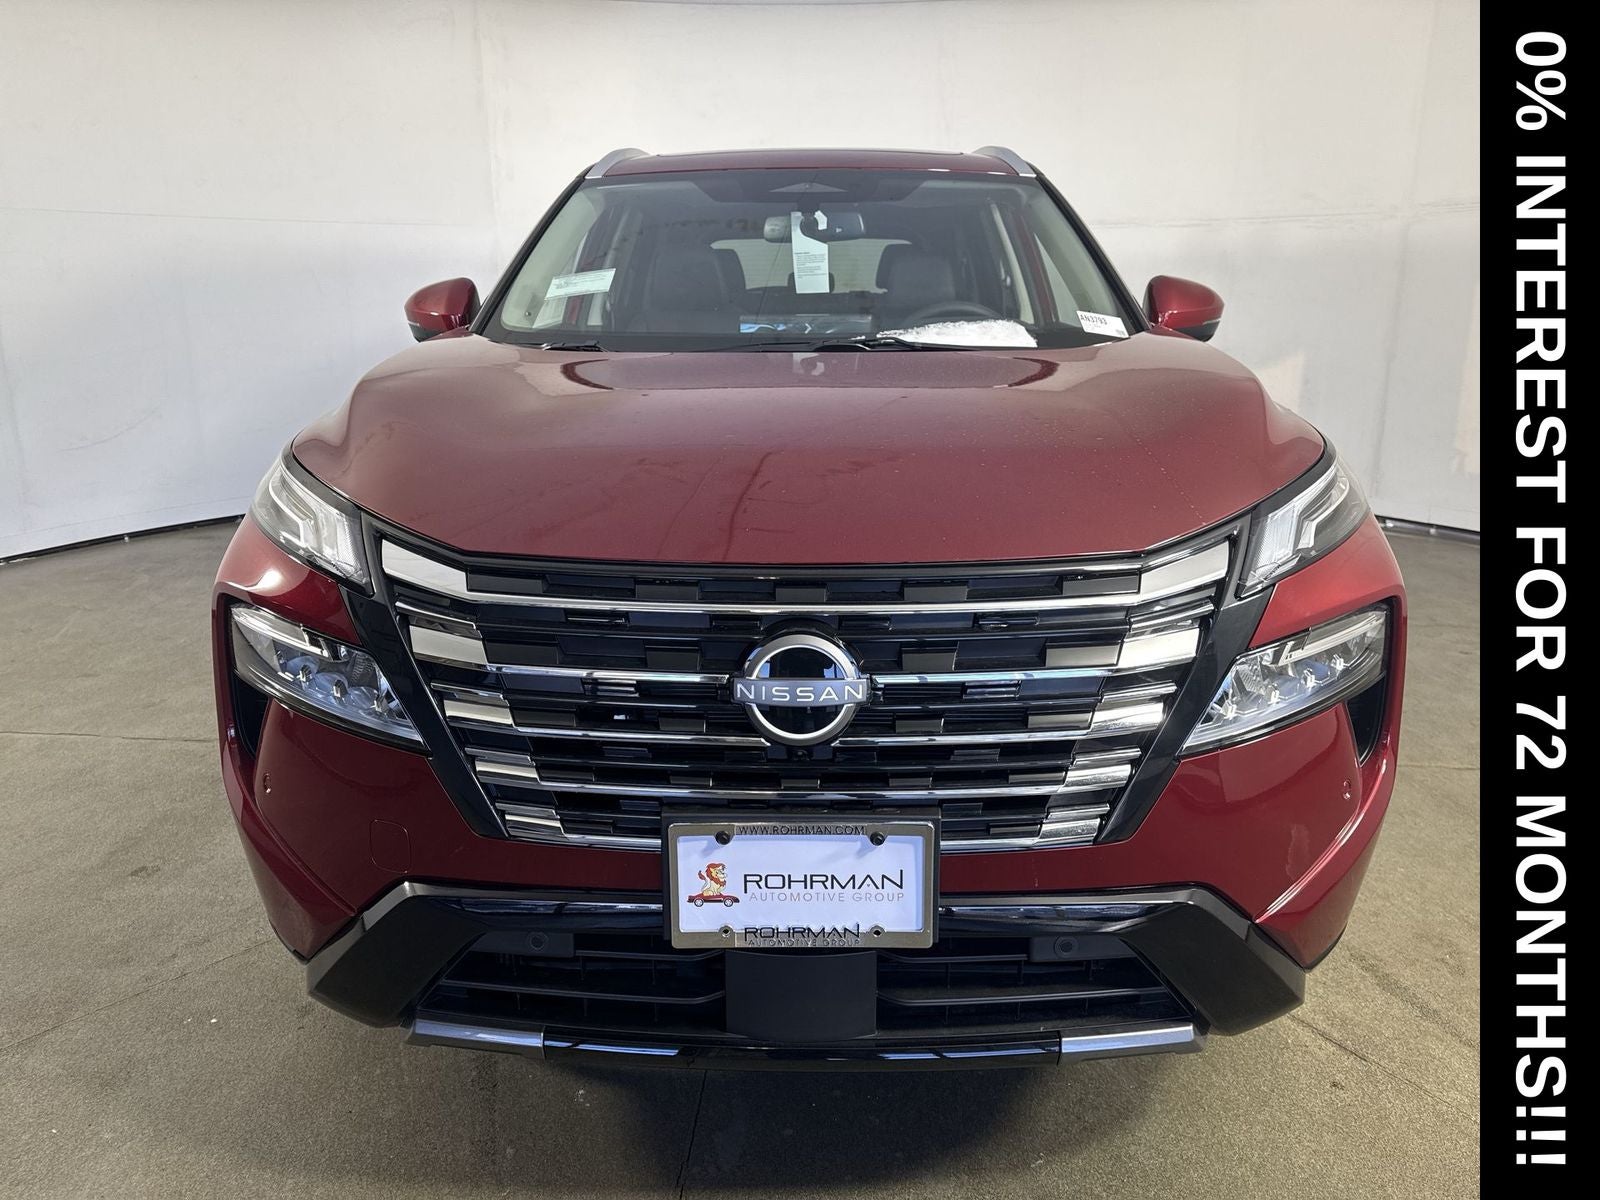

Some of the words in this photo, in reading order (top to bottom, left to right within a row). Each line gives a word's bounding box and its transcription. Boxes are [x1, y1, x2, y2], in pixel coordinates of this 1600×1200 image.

[736, 683, 863, 702] NISSAN
[739, 825, 865, 836] WWW.ROHRMAN.COM
[743, 869, 904, 894] ROHRMAN
[749, 892, 845, 902] AUTOMOTIVE
[852, 892, 905, 902] GROUP
[744, 923, 860, 941] ROHRMAN
[748, 939, 817, 947] AUTOMOTIVE
[823, 939, 860, 947] GROUP
